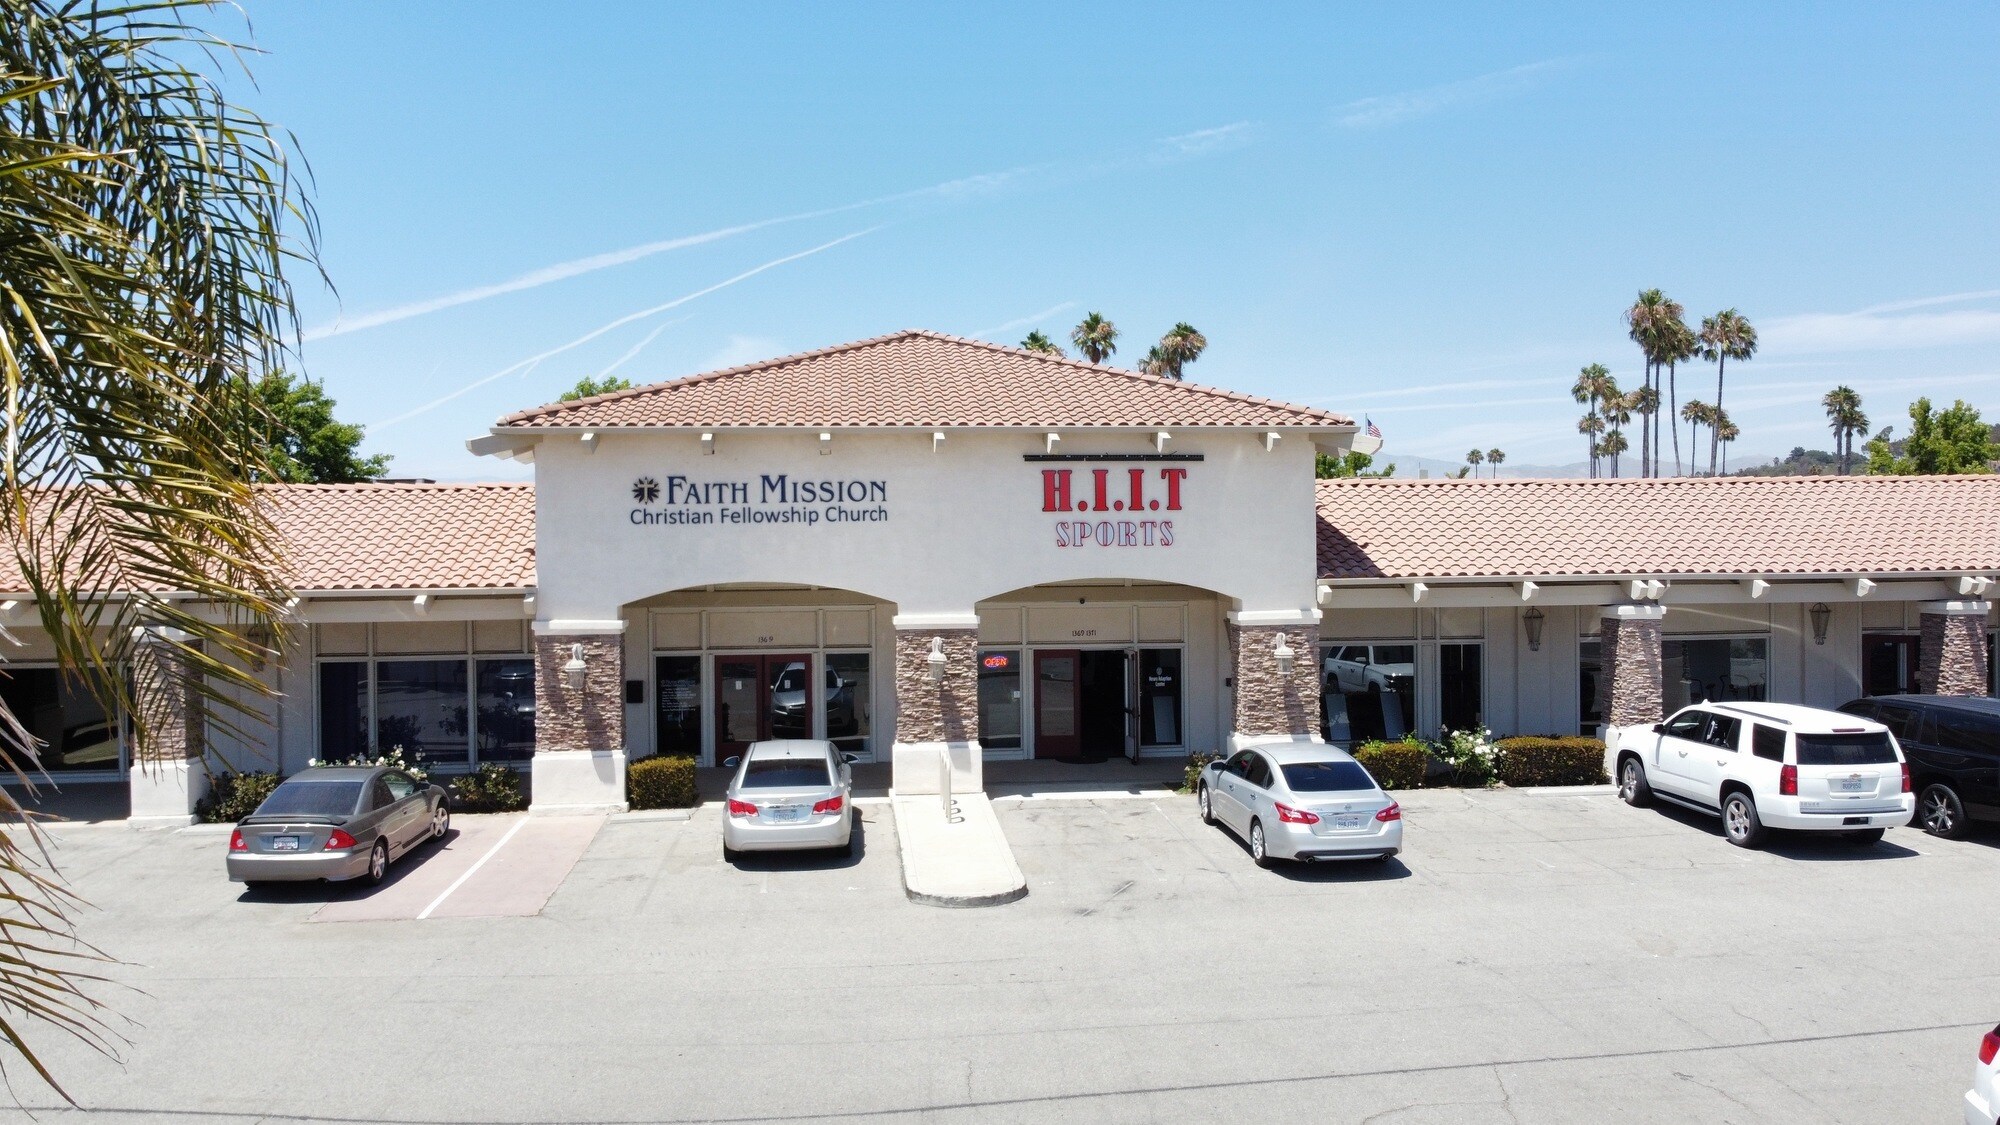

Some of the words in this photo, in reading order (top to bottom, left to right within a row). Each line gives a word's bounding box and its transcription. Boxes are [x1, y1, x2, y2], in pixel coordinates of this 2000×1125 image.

[667, 476, 748, 504] FAITH
[760, 475, 887, 503] MISSION
[1041, 469, 1187, 512] H.I.I.T
[630, 508, 713, 525] Christian
[721, 507, 819, 526] Fellowship
[825, 506, 888, 522] Church
[1055, 521, 1174, 547] SPORTS
[984, 657, 1008, 666] OPEN
